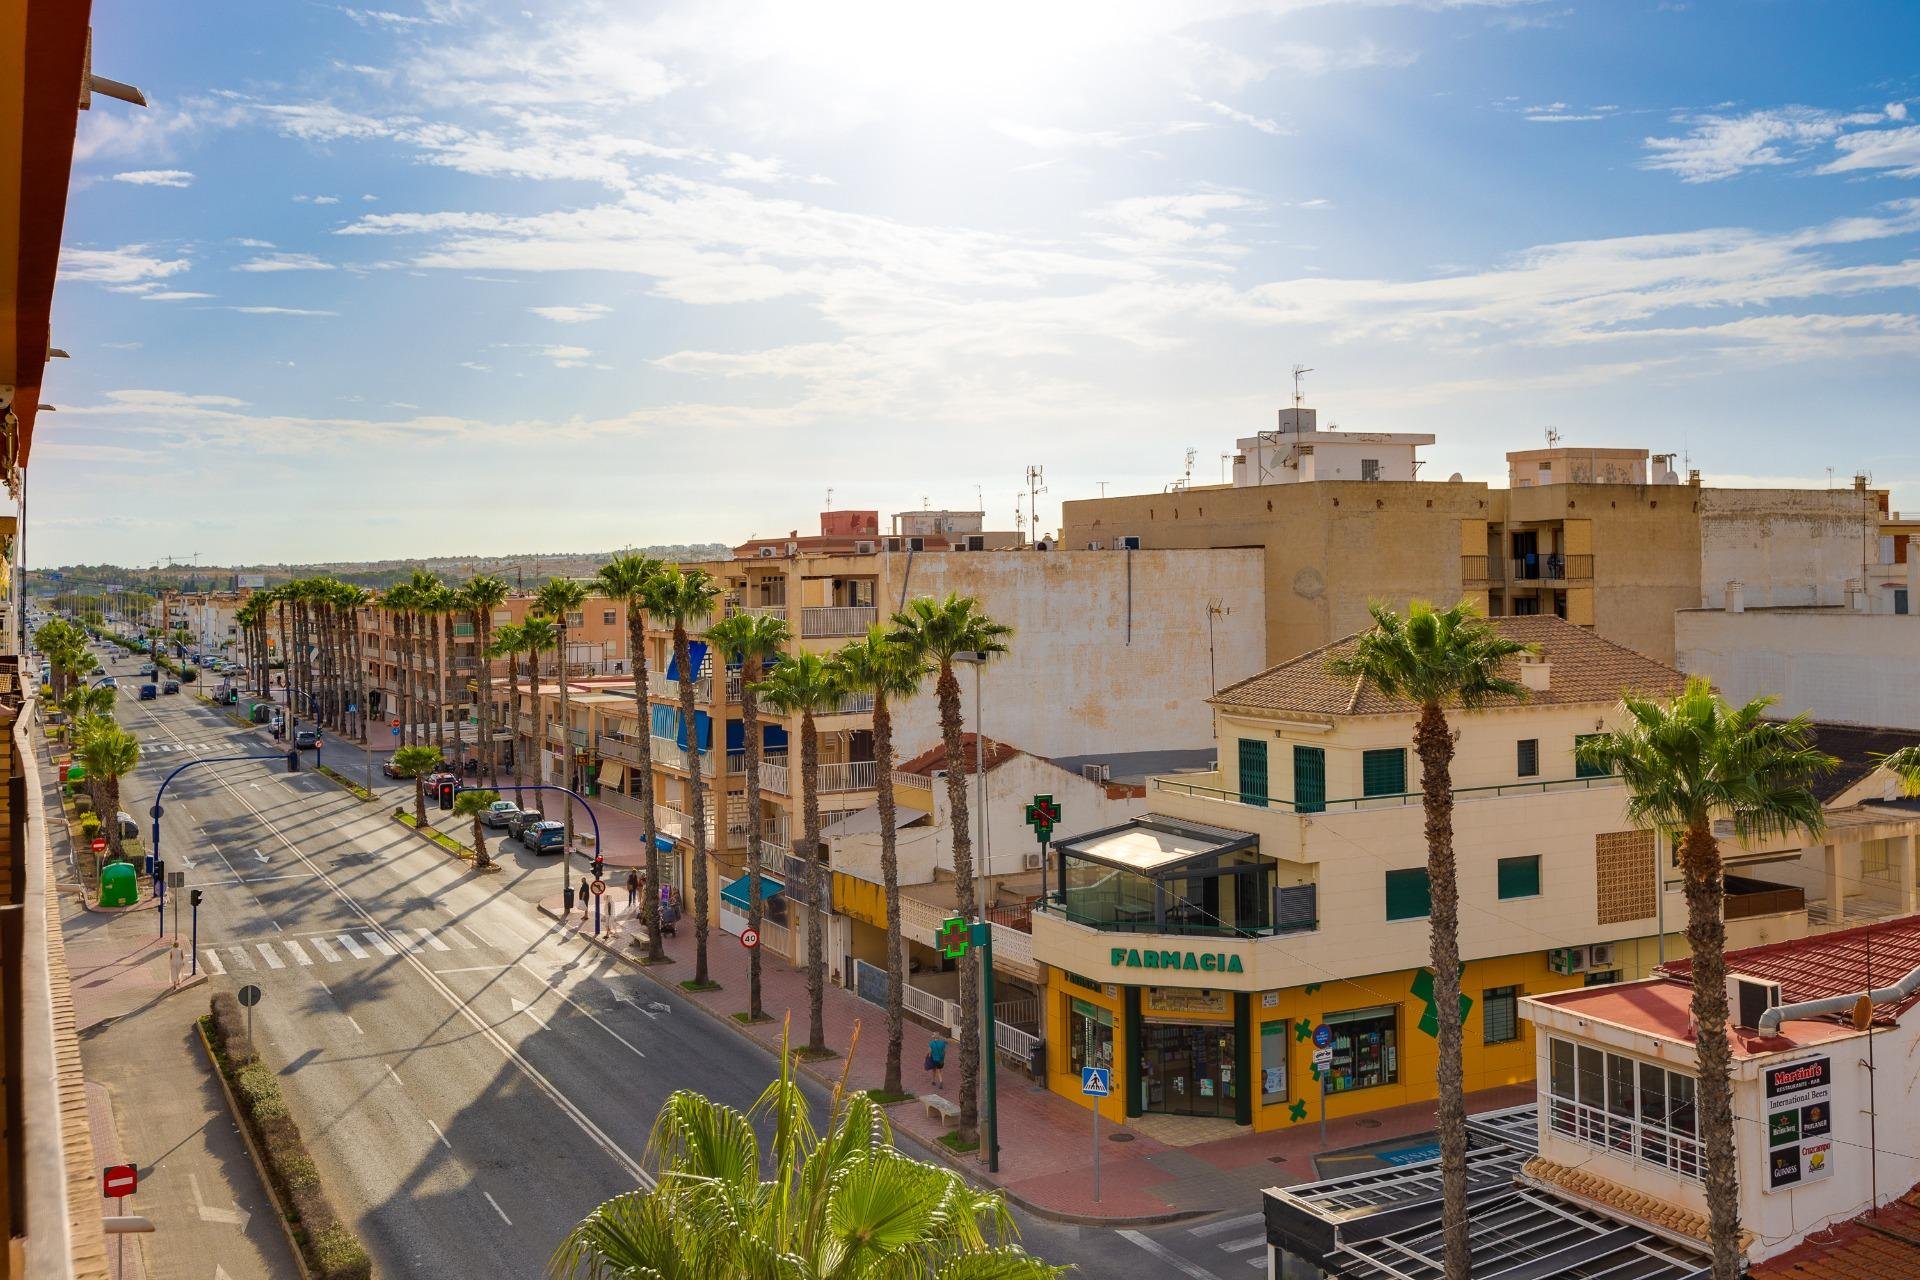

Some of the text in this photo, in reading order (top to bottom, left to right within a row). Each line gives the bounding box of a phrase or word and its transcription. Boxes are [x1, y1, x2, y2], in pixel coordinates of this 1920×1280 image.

[1111, 948, 1244, 973] FARMACIA
[1775, 1063, 1822, 1085] Martini's
[1776, 1081, 1807, 1093] RESTAURANTE
[1770, 1089, 1828, 1109] International Beers
[1773, 1125, 1796, 1136] Heineken
[1803, 1120, 1827, 1131] PAULANER
[1801, 1142, 1831, 1156] Cruzcampo
[1774, 1165, 1797, 1177] GUINNESS
